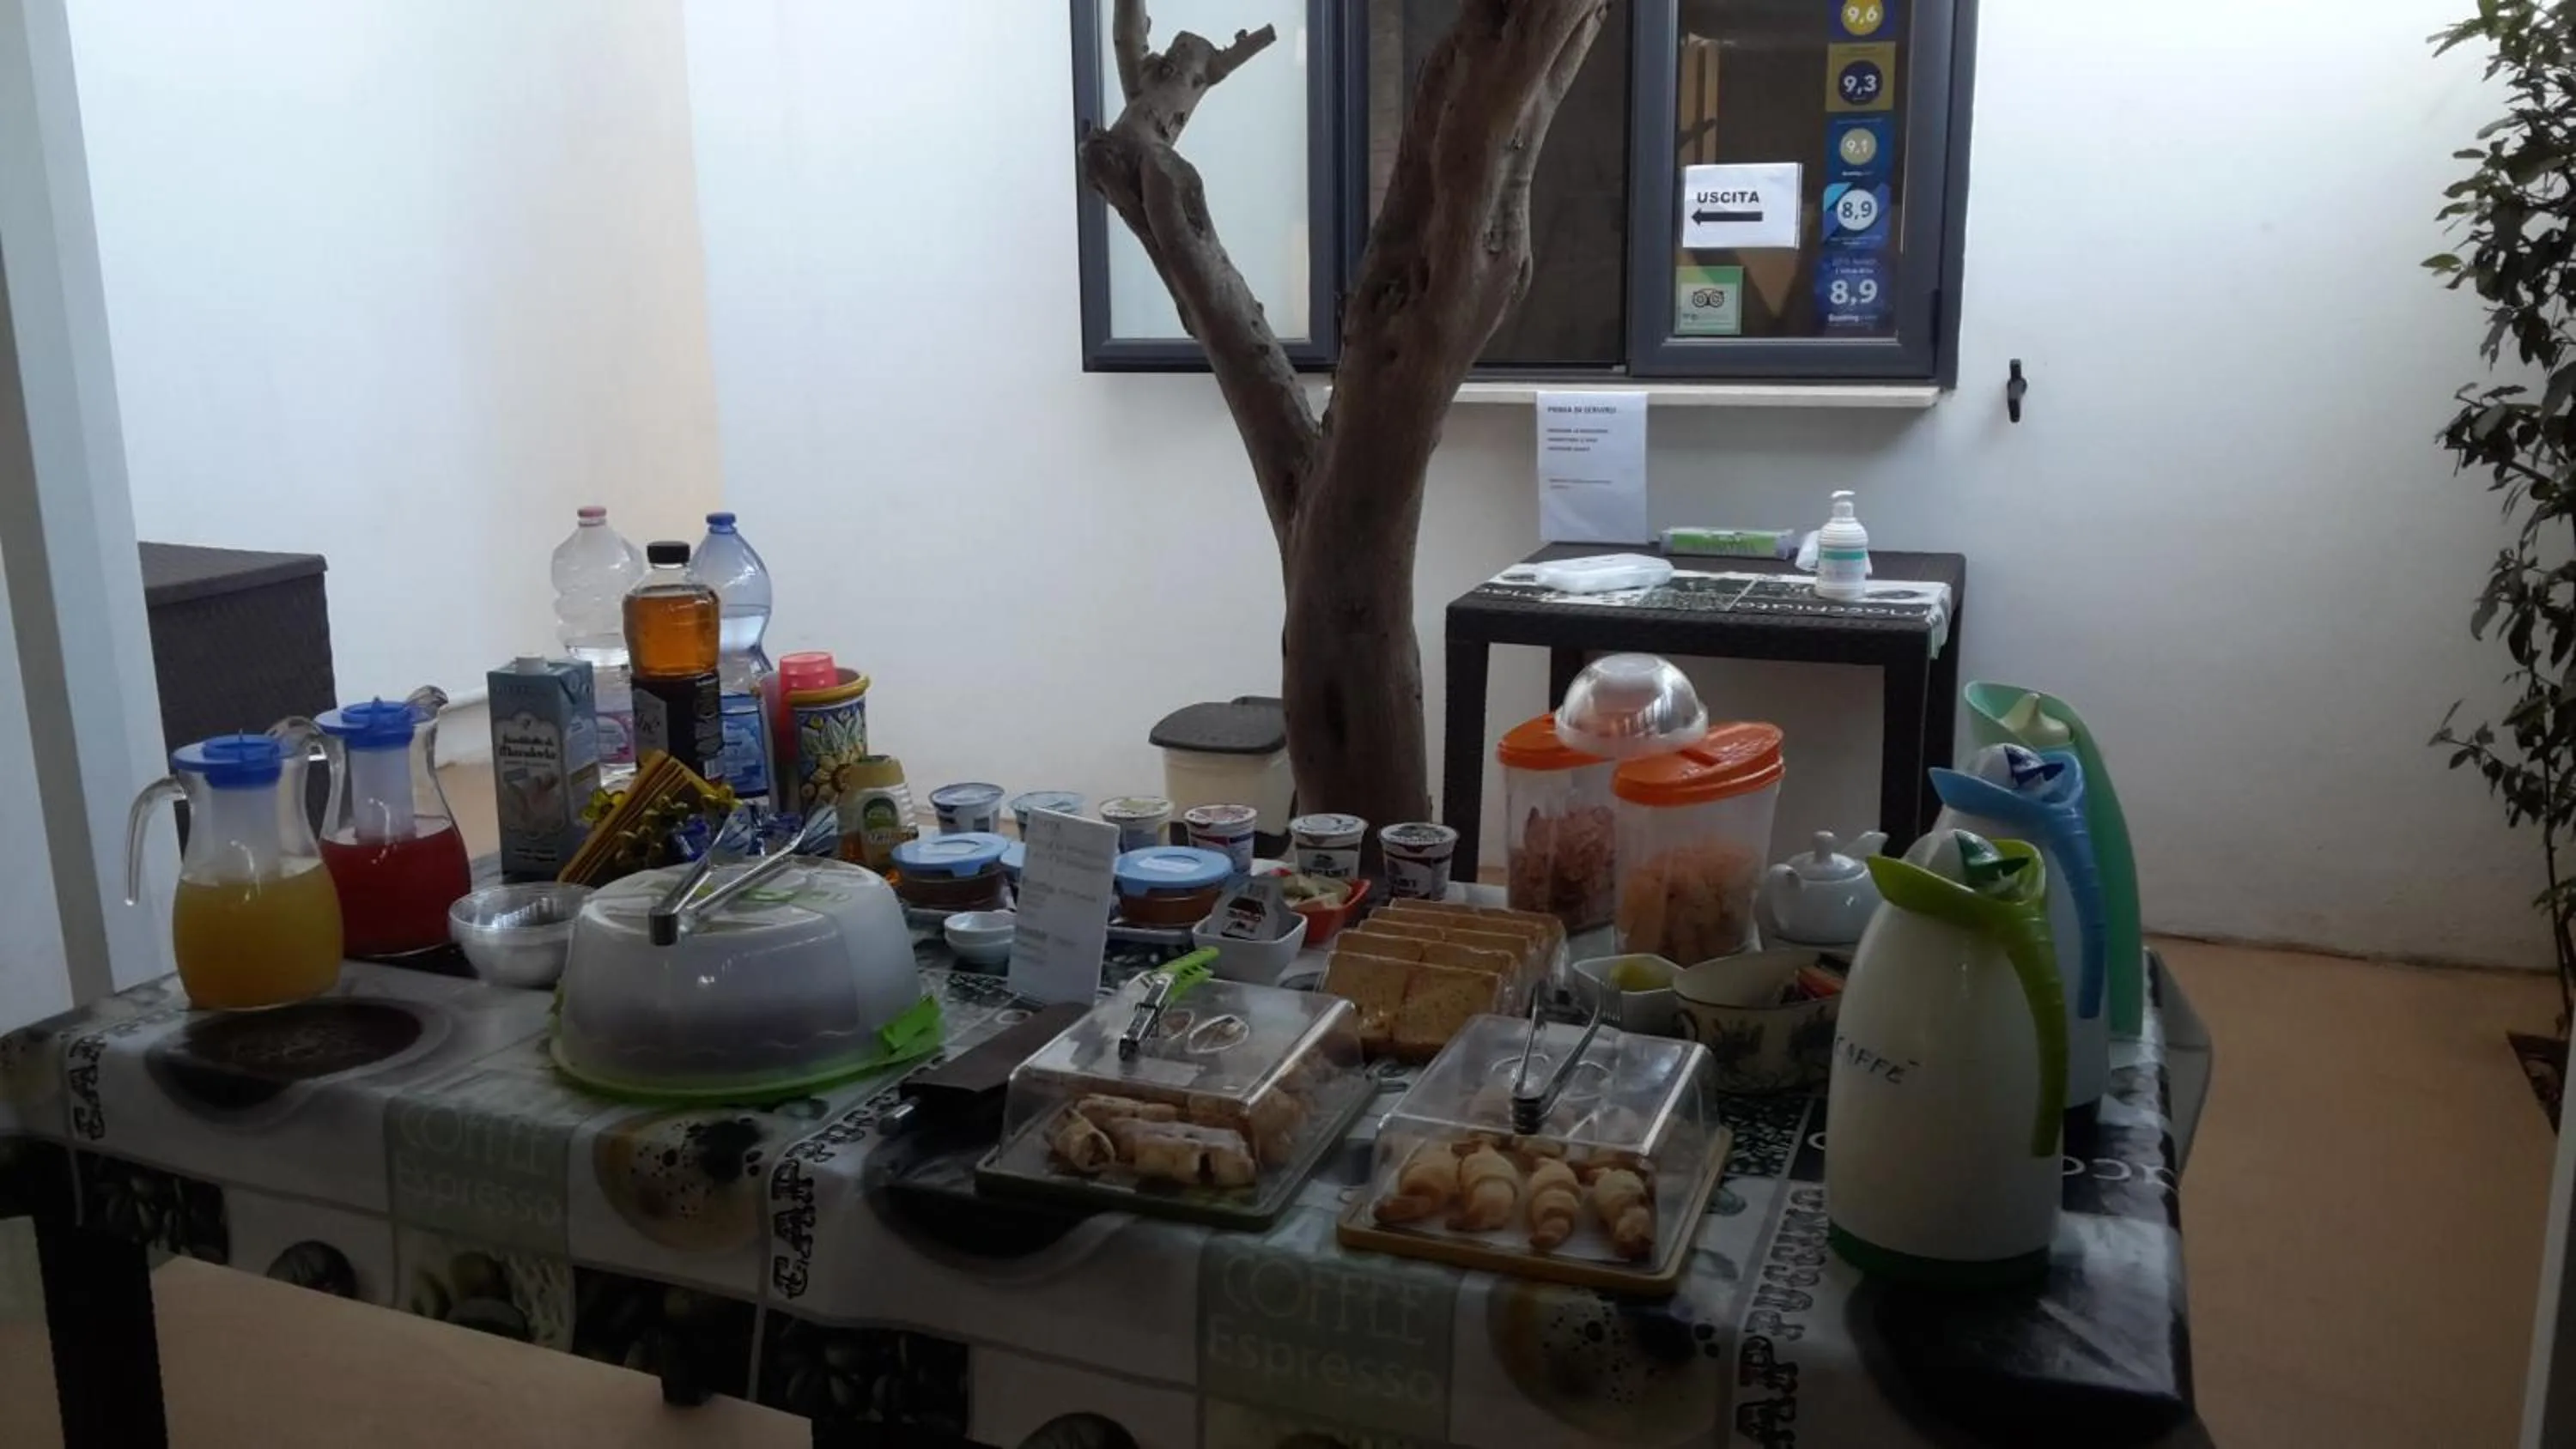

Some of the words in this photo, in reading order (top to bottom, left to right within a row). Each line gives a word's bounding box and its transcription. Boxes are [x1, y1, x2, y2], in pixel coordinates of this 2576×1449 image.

[1844, 75, 1877, 94] 9,3
[1696, 191, 1760, 204] USCITA
[1842, 201, 1873, 221] 8,9
[1830, 279, 1879, 306] 8,9
[1207, 1313, 1440, 1403] Espresso
